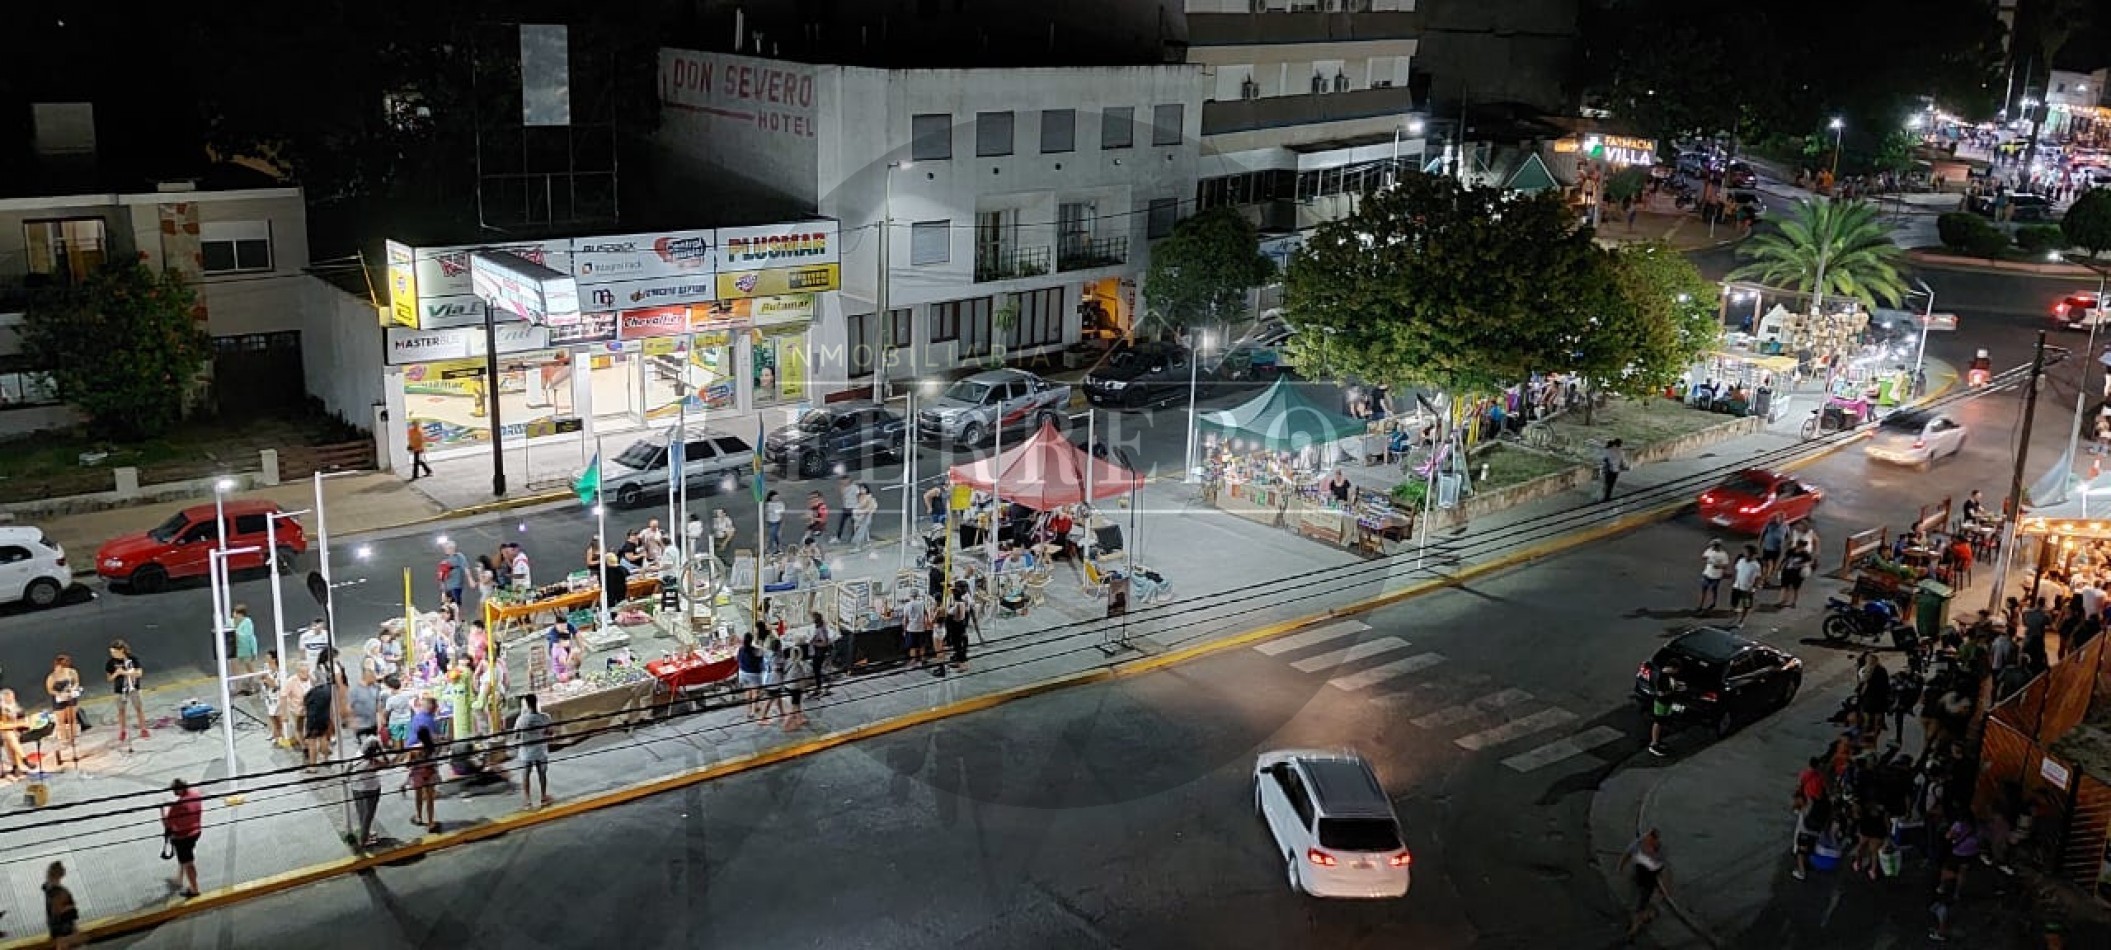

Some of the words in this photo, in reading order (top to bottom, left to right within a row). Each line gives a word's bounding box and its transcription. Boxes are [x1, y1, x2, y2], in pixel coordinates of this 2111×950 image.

[673, 58, 712, 93] DON
[724, 65, 812, 107] SEVERO
[758, 109, 813, 137] HOTEL
[1605, 147, 1651, 165] VILLA
[728, 232, 825, 262] PLUSMAR
[622, 313, 684, 328] Chevallier
